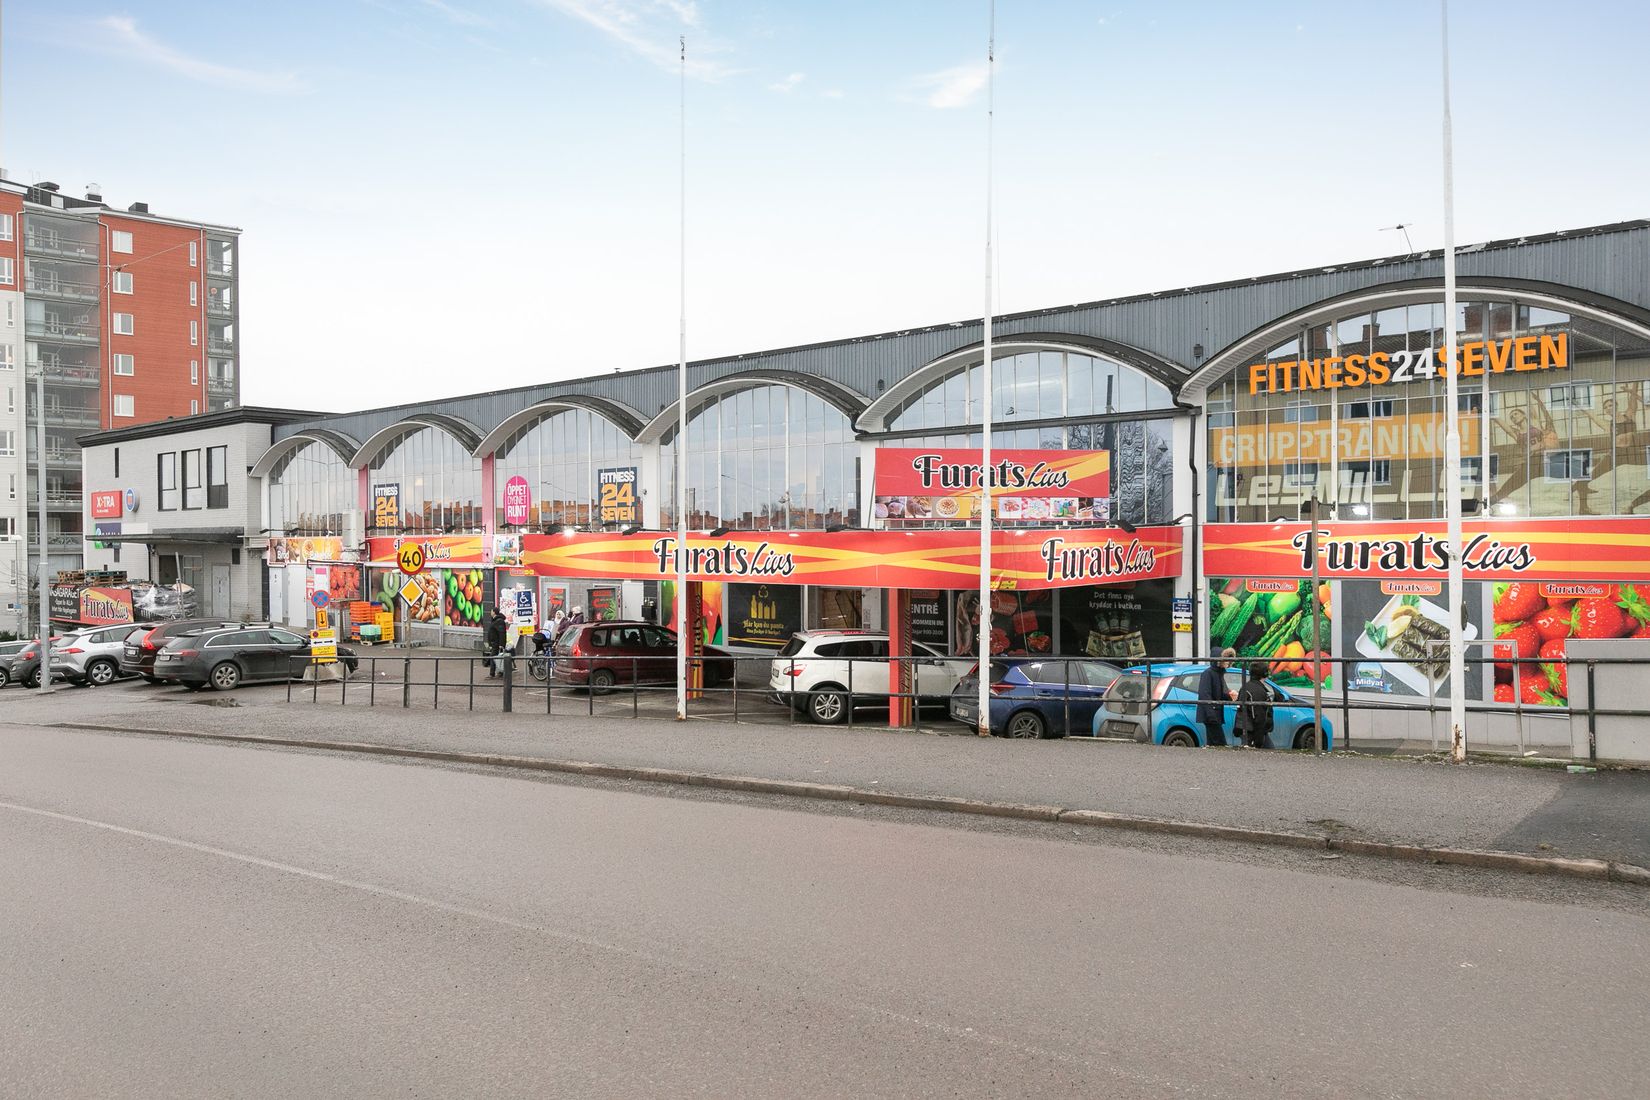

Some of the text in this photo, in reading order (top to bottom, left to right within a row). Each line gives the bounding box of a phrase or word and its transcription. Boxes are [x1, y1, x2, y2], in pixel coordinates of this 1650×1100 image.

[1249, 333, 1568, 395] FITNESS24SEVEN
[600, 471, 635, 483] FITNESS
[375, 486, 398, 496] FITNESS
[508, 484, 526, 495] ÖPPET
[601, 483, 635, 507] 24
[376, 496, 398, 515] 24
[508, 506, 526, 517] RUNT
[376, 515, 398, 526] SEVEN
[601, 507, 635, 521] SEVEN
[1293, 530, 1450, 570] Furats
[402, 551, 421, 567] 40
[1356, 678, 1384, 687] Midyat
